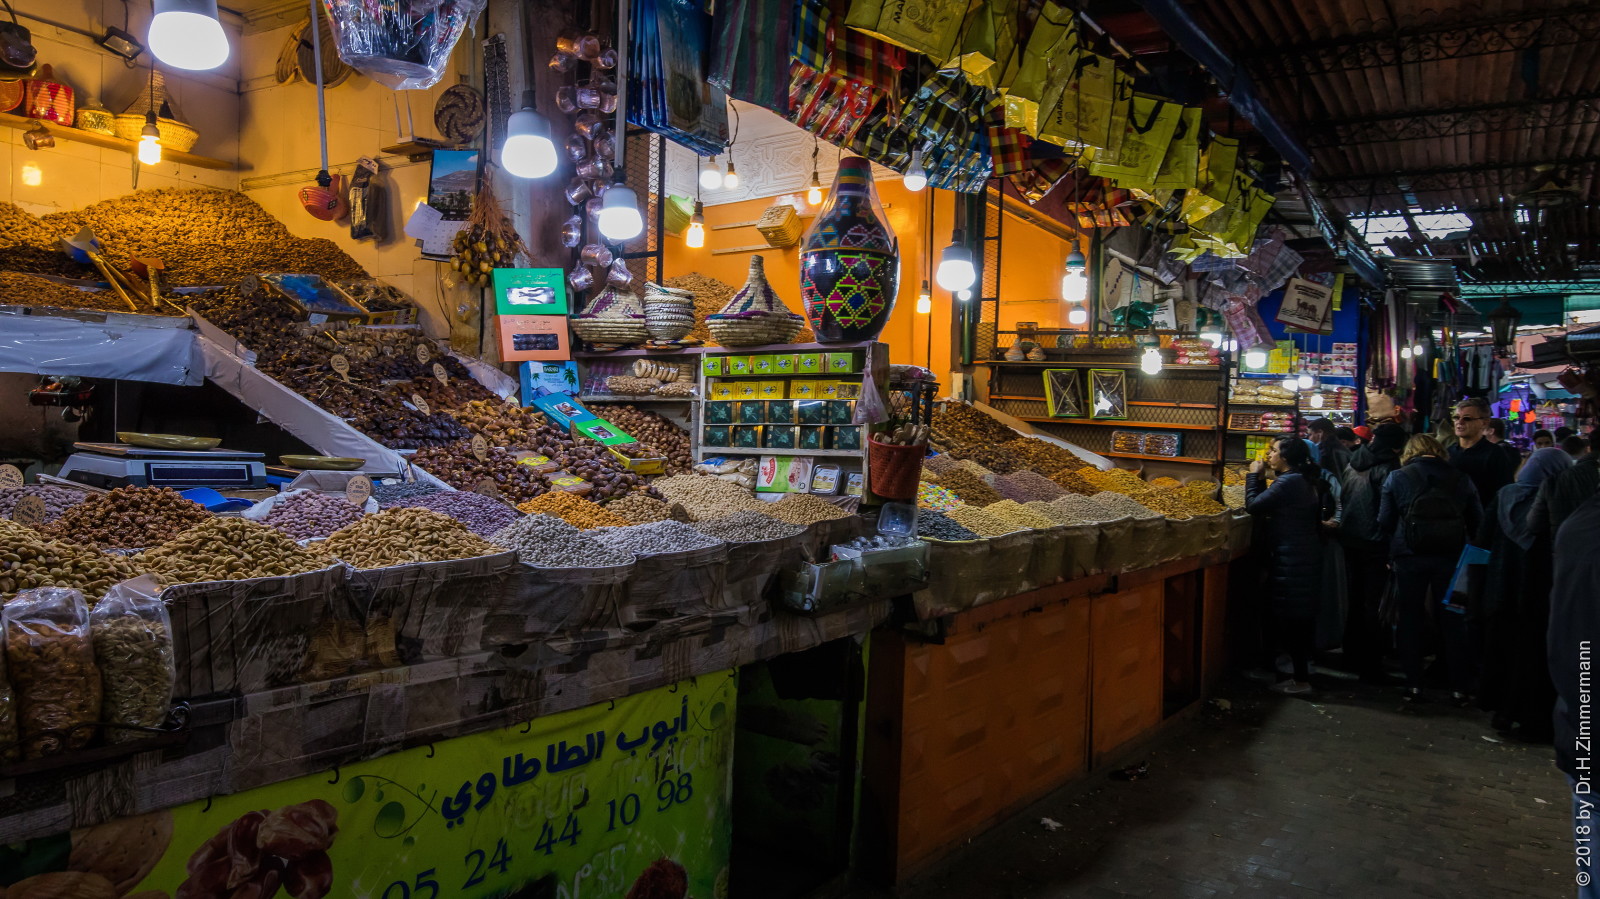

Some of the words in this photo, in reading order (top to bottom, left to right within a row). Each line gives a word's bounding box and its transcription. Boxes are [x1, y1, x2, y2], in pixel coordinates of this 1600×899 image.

[616, 695, 688, 757] أيوب
[441, 731, 606, 829] الطاطاوي
[460, 836, 513, 891] 24
[534, 813, 583, 856] 44
[606, 793, 641, 832] 10
[657, 773, 693, 812] 98
